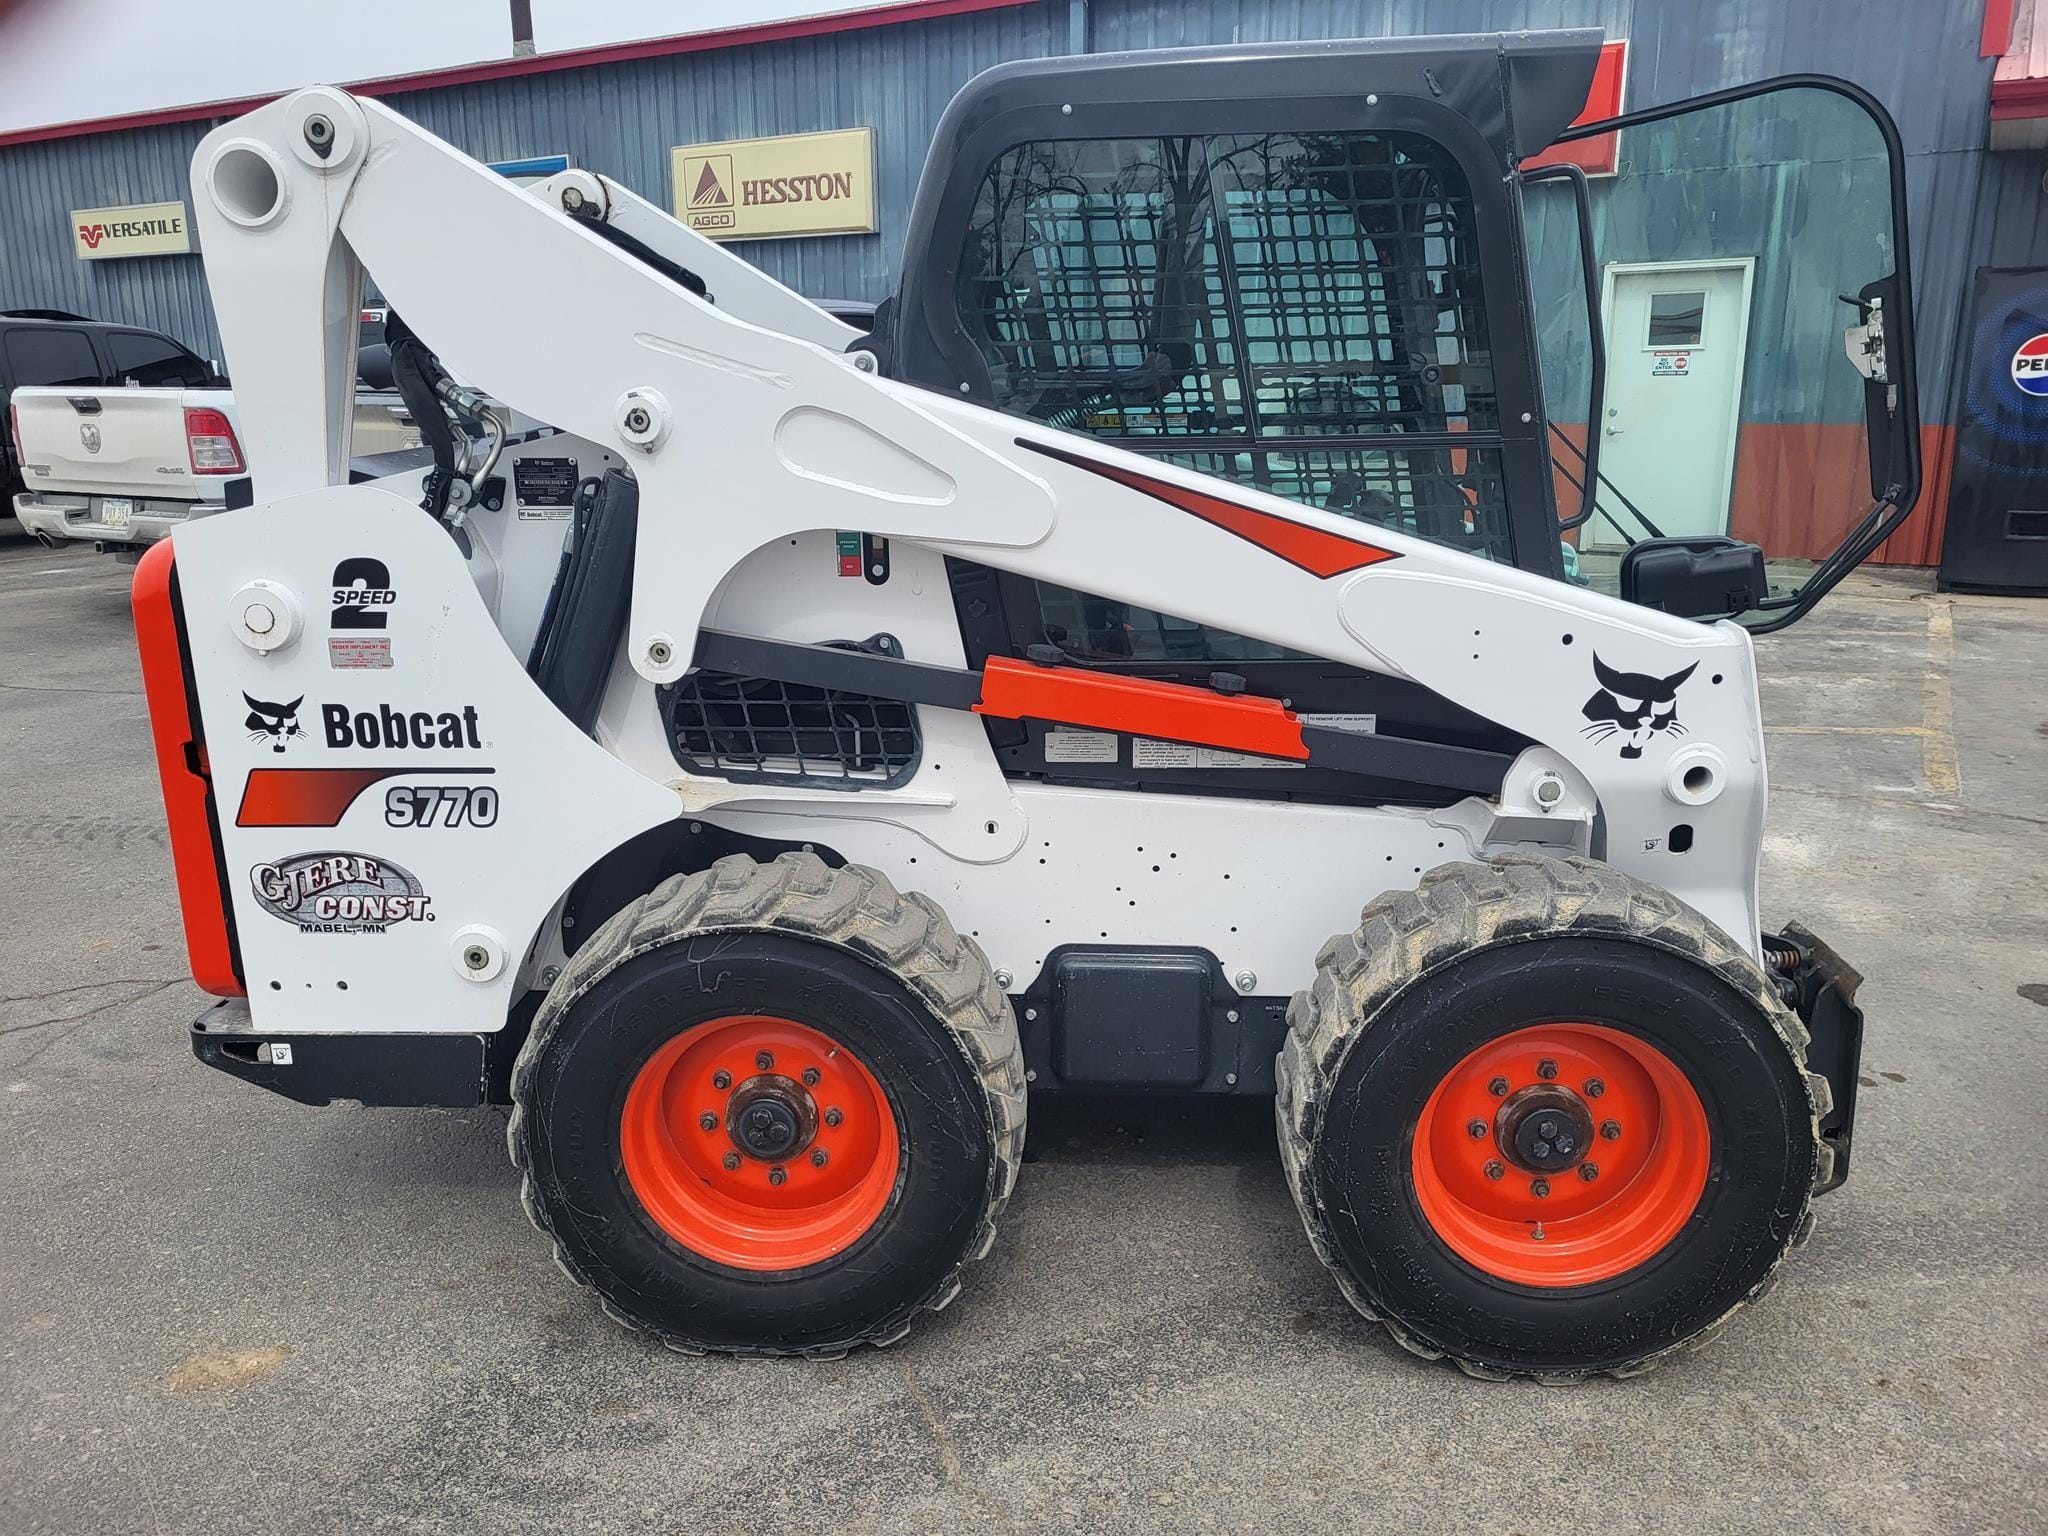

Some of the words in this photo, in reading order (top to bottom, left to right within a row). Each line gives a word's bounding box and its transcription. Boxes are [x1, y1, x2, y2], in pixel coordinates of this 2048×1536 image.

[742, 172, 853, 206] HESSTON
[103, 217, 182, 240] VERSATILE
[693, 214, 730, 227] AGCO
[331, 557, 390, 629] 2
[332, 590, 397, 605] SPEED
[321, 703, 482, 749] Bobcat
[385, 786, 499, 828] S770
[250, 856, 385, 911] GJERE
[313, 894, 436, 922] CONST.
[362, 924, 386, 933] MN
